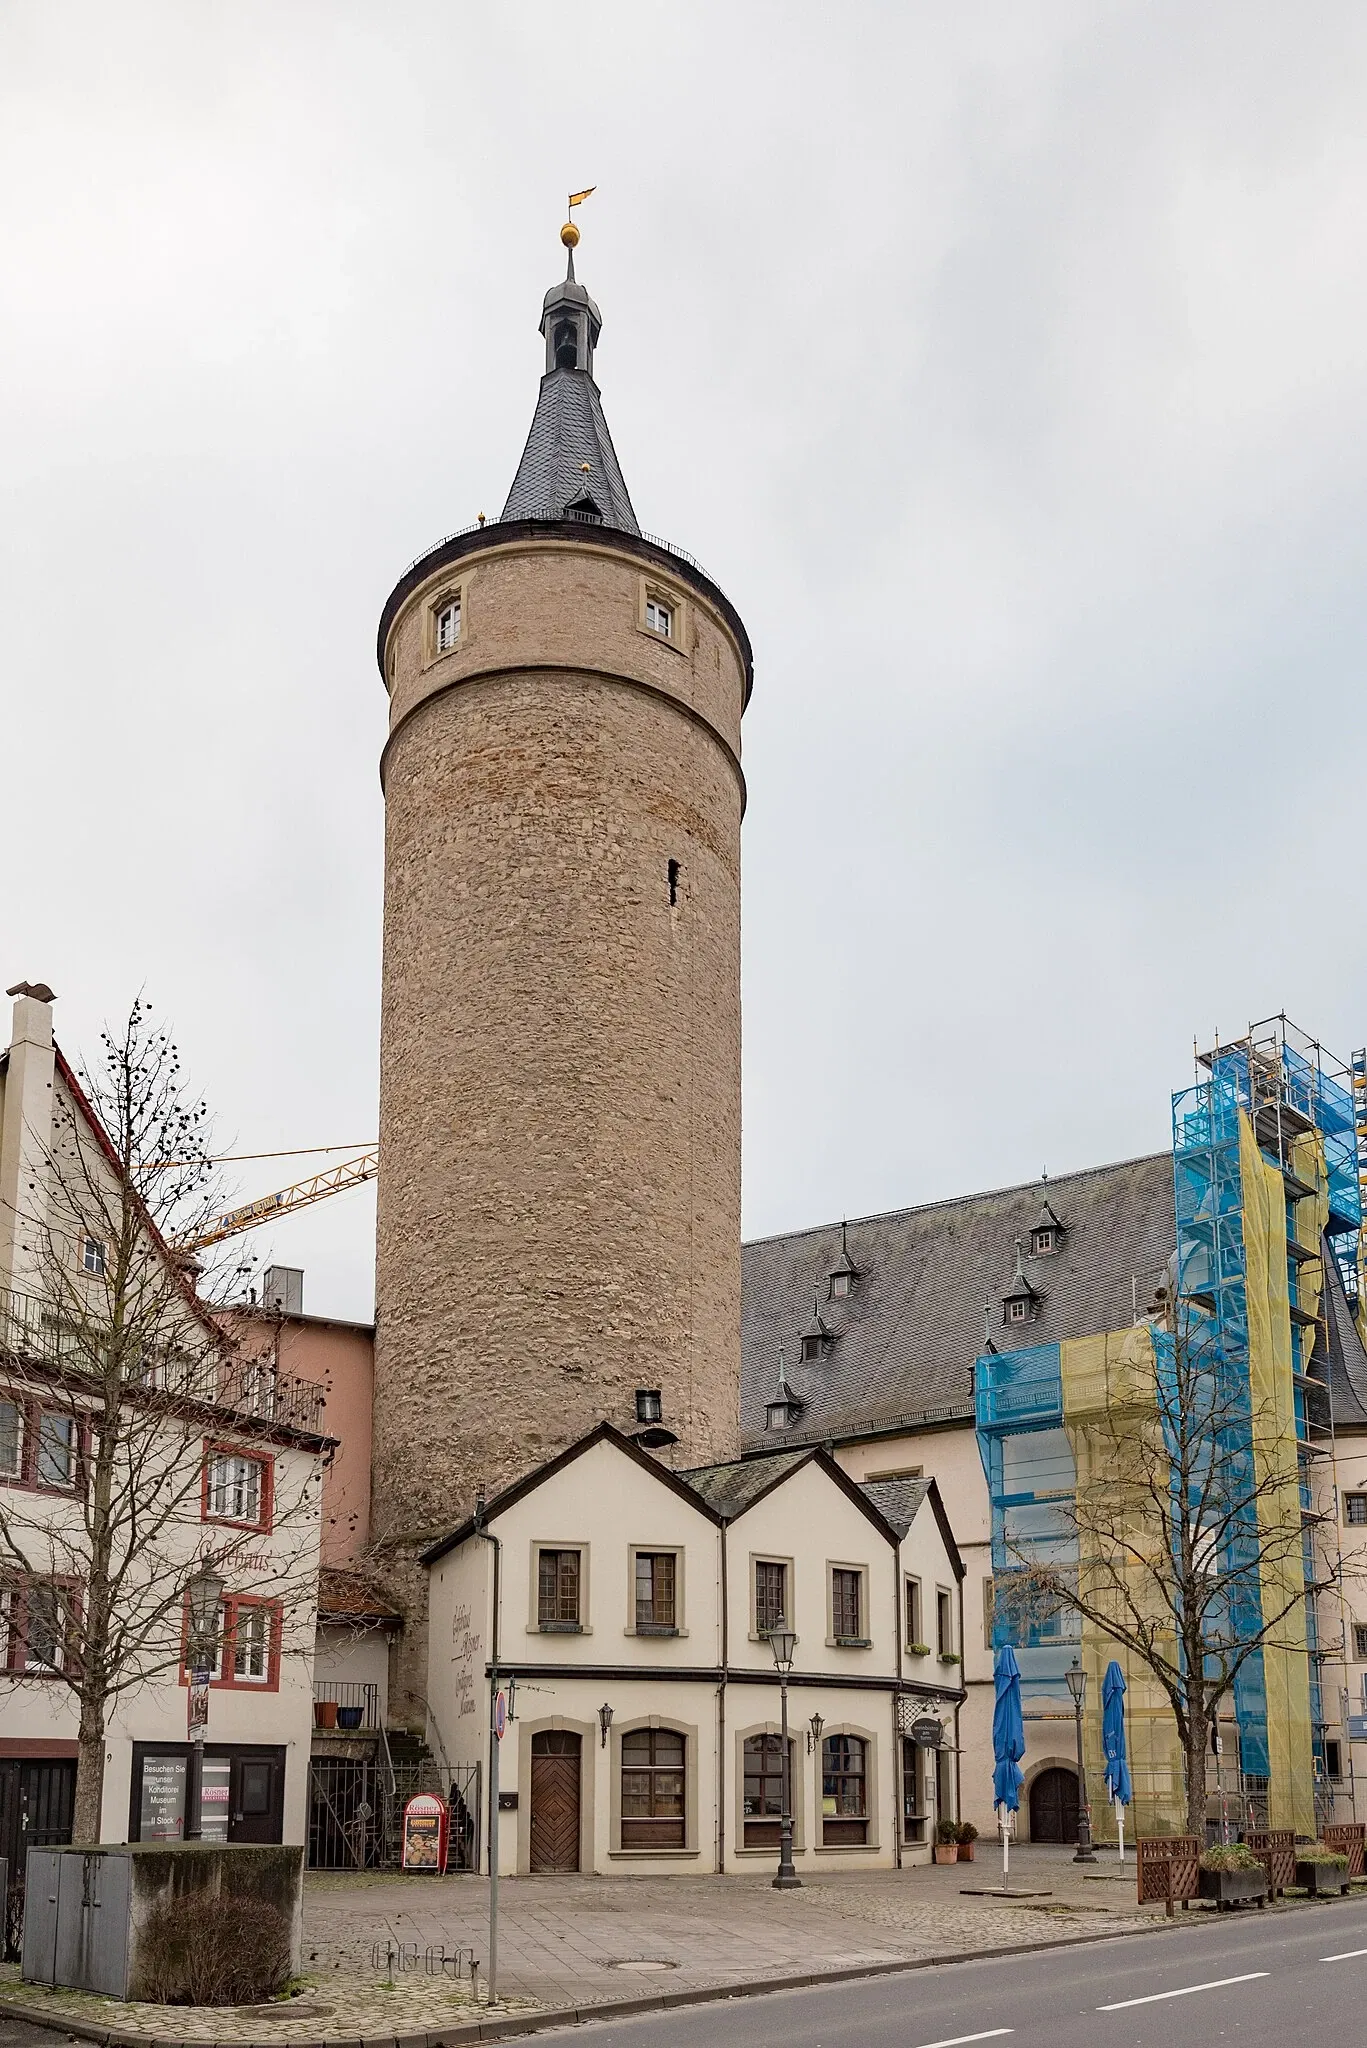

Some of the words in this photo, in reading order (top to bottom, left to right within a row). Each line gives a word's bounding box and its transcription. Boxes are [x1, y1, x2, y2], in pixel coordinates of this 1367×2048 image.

[107, 1753, 112, 1763] 9
[144, 1765, 175, 1773] Besuchen
[175, 1765, 185, 1773] Sie
[148, 1785, 179, 1794] Konditorei
[204, 1787, 228, 1796] Rösner
[150, 1796, 176, 1804] Museum
[159, 1806, 167, 1814] im
[156, 1817, 174, 1825] Stock
